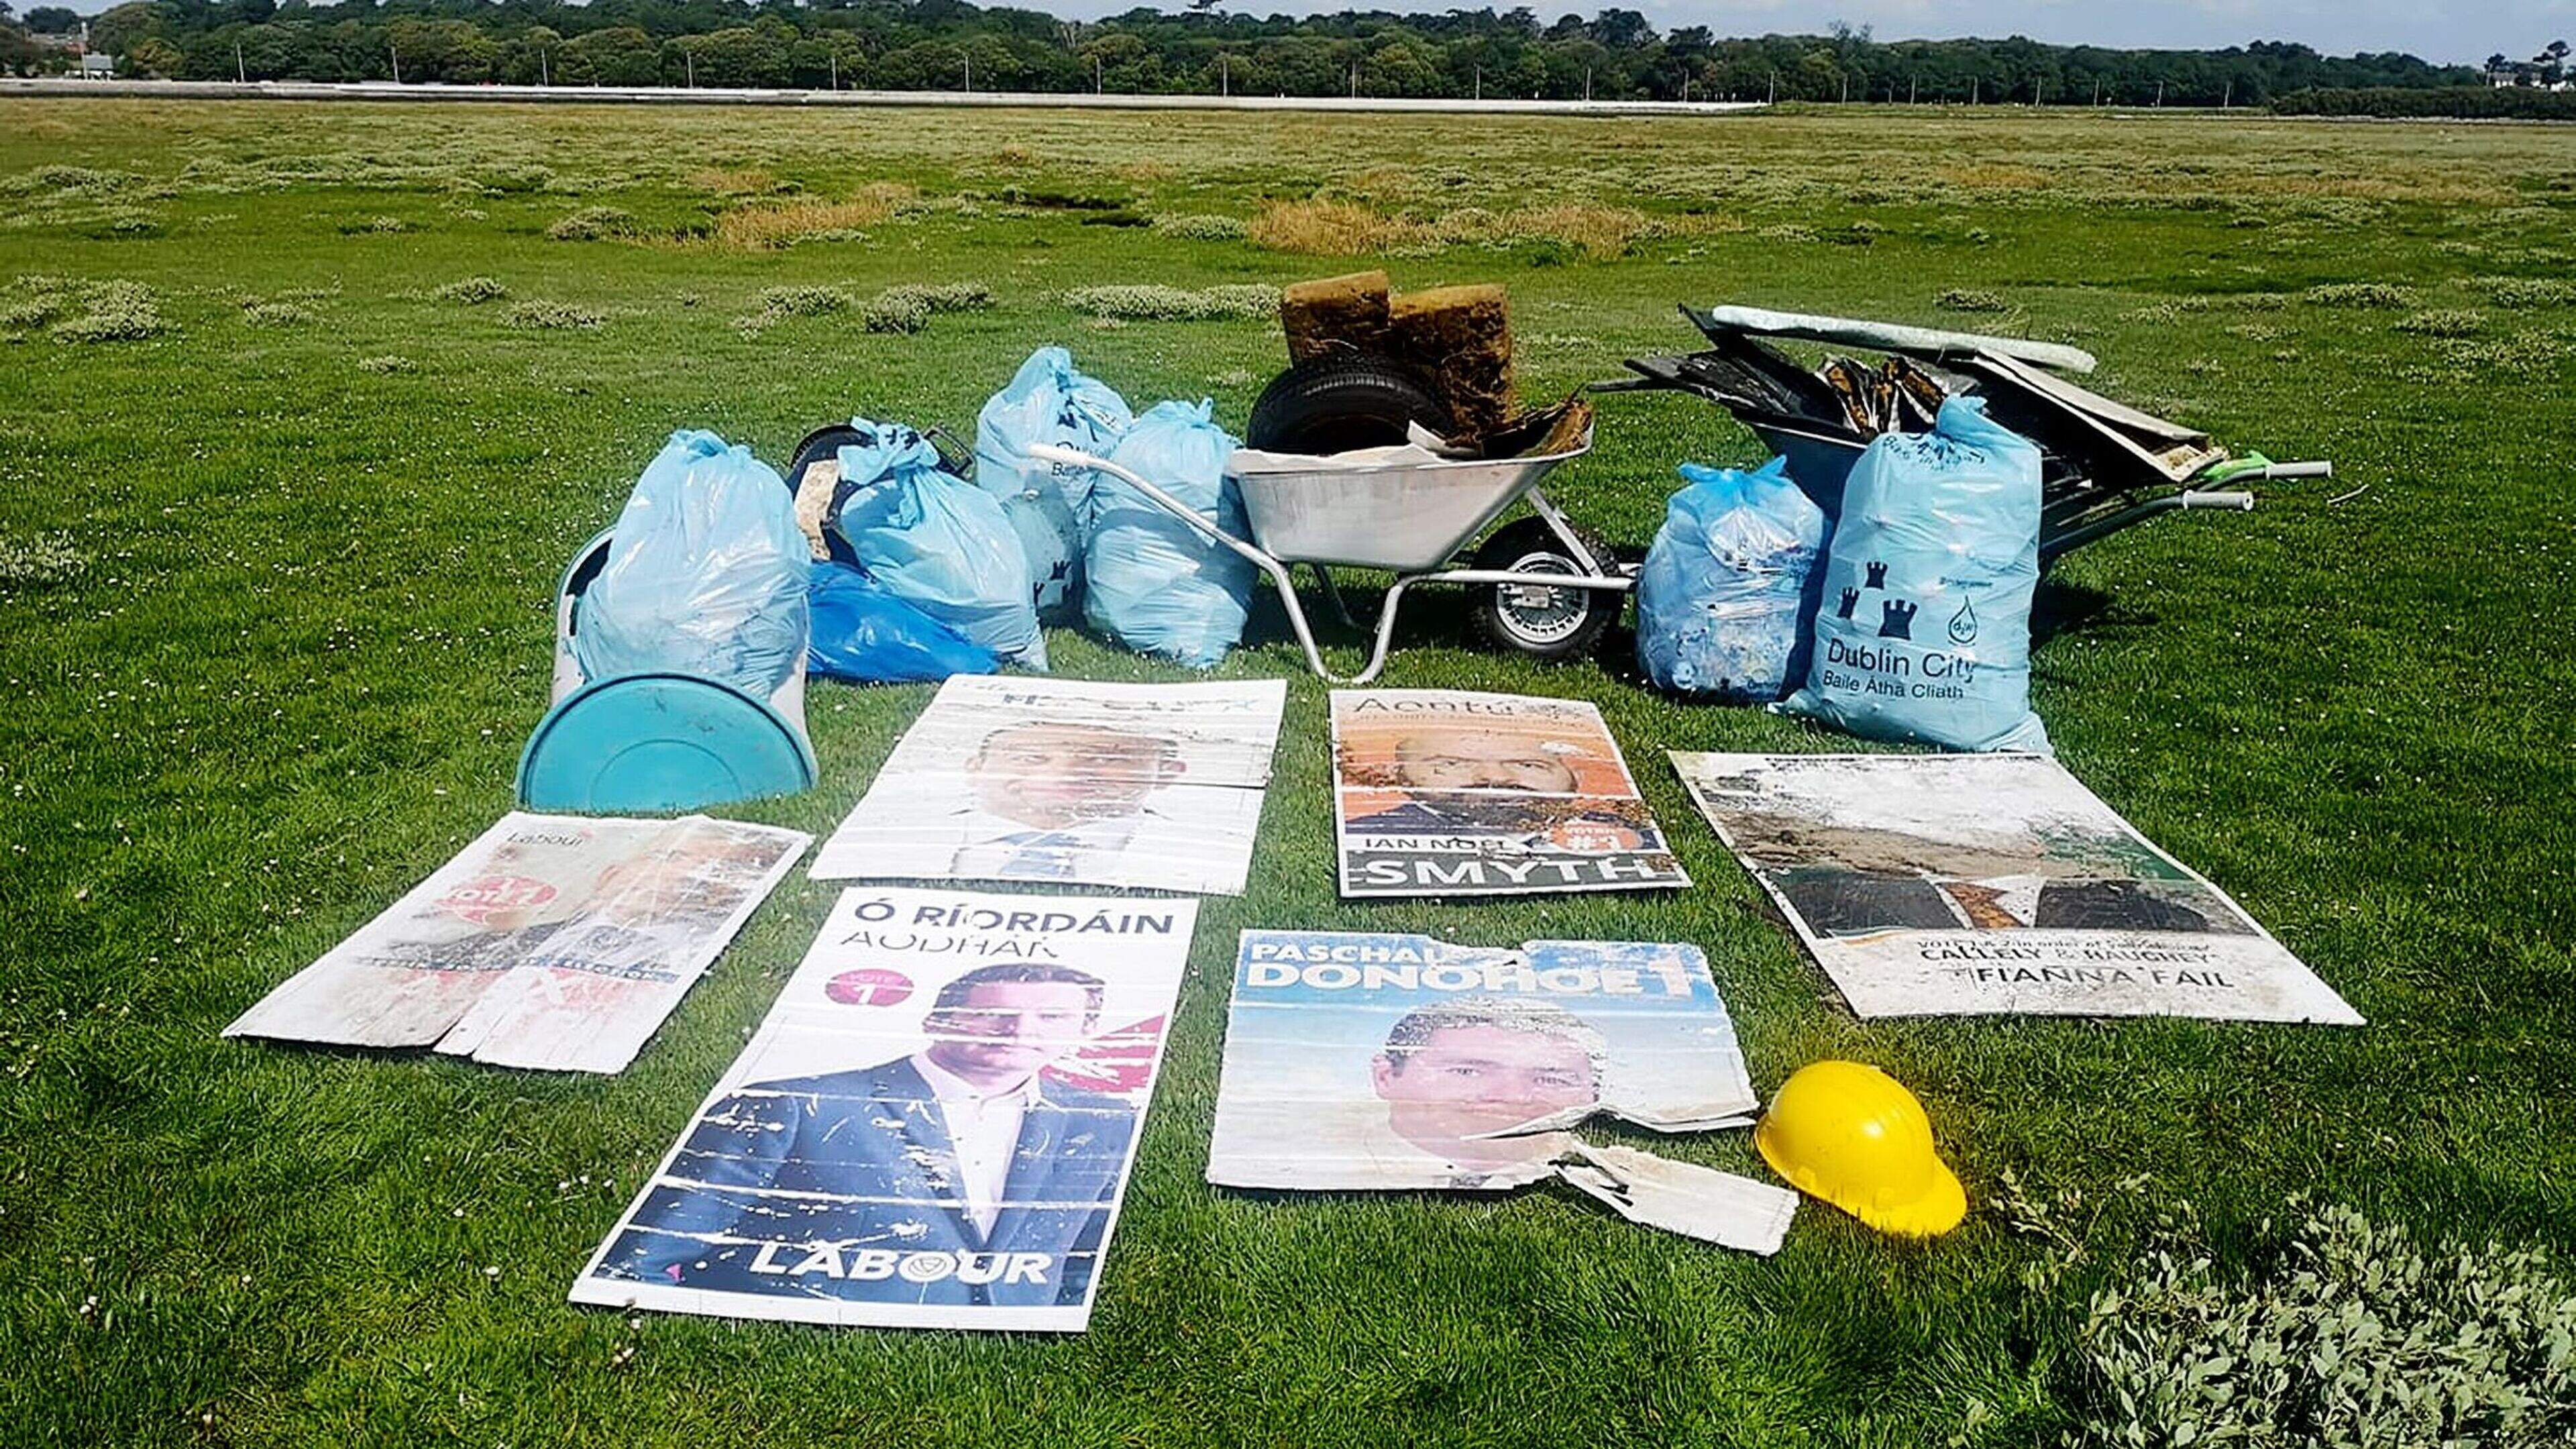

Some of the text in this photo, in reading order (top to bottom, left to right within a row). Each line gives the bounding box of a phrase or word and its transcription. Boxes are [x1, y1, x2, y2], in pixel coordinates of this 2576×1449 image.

[1828, 637, 1975, 684] Dublin City
[1823, 670, 1964, 700] Baile Átha Cliath
[1354, 698, 1516, 716] Aontú
[1365, 838, 1411, 849] IAN
[1365, 857, 1658, 885] SMYTH
[855, 898, 1174, 934] Ó RÍORDÁIN
[1251, 943, 1456, 965] PASCHAL
[1920, 945, 2041, 961] CALLELY
[2083, 949, 2210, 964] HAUGHEY
[1246, 961, 1645, 996] DONOHOE
[1977, 967, 2137, 985] FIANNA
[853, 982, 877, 1004] 1
[749, 1240, 1053, 1285] LABOUR
